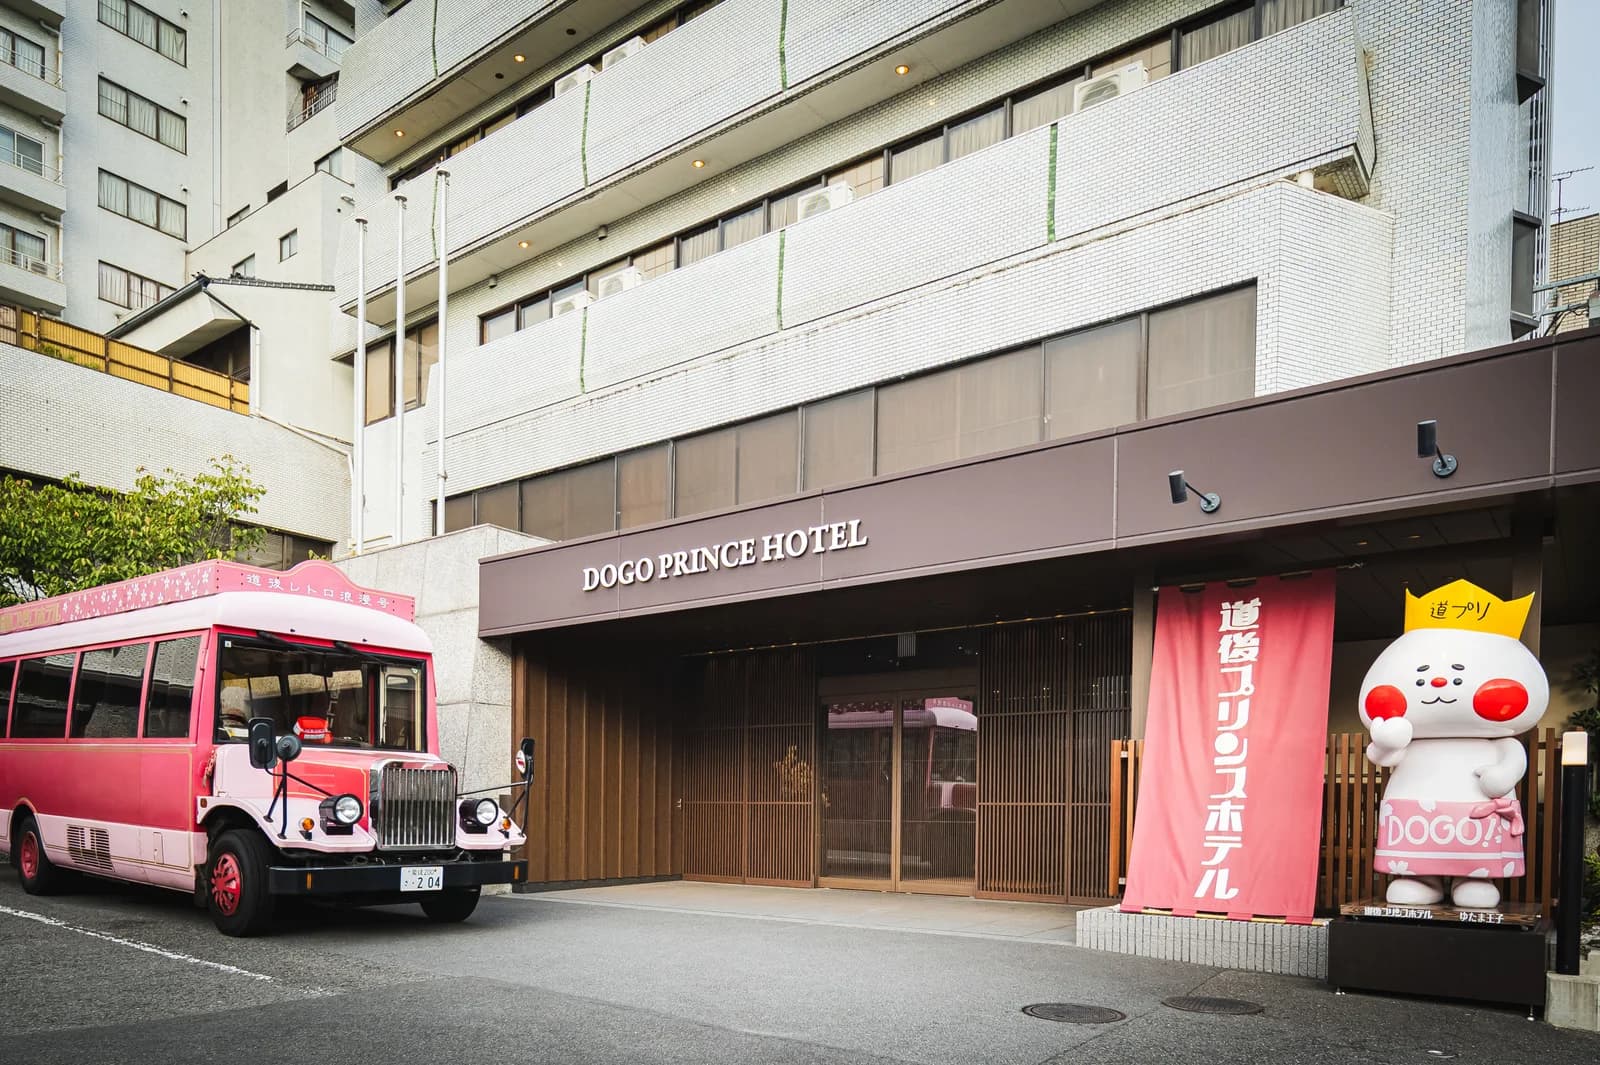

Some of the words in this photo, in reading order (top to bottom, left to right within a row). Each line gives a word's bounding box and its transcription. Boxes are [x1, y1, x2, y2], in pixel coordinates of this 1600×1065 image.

[582, 557, 655, 593] DOGO
[658, 538, 757, 579] PRINCE
[761, 519, 869, 563] HOTEL
[246, 573, 390, 609] 道後レトロ浪漫号
[1430, 600, 1491, 621] 道プリ
[1194, 597, 1262, 900] 道後プリンスホテル
[1387, 815, 1497, 848] DOGO!
